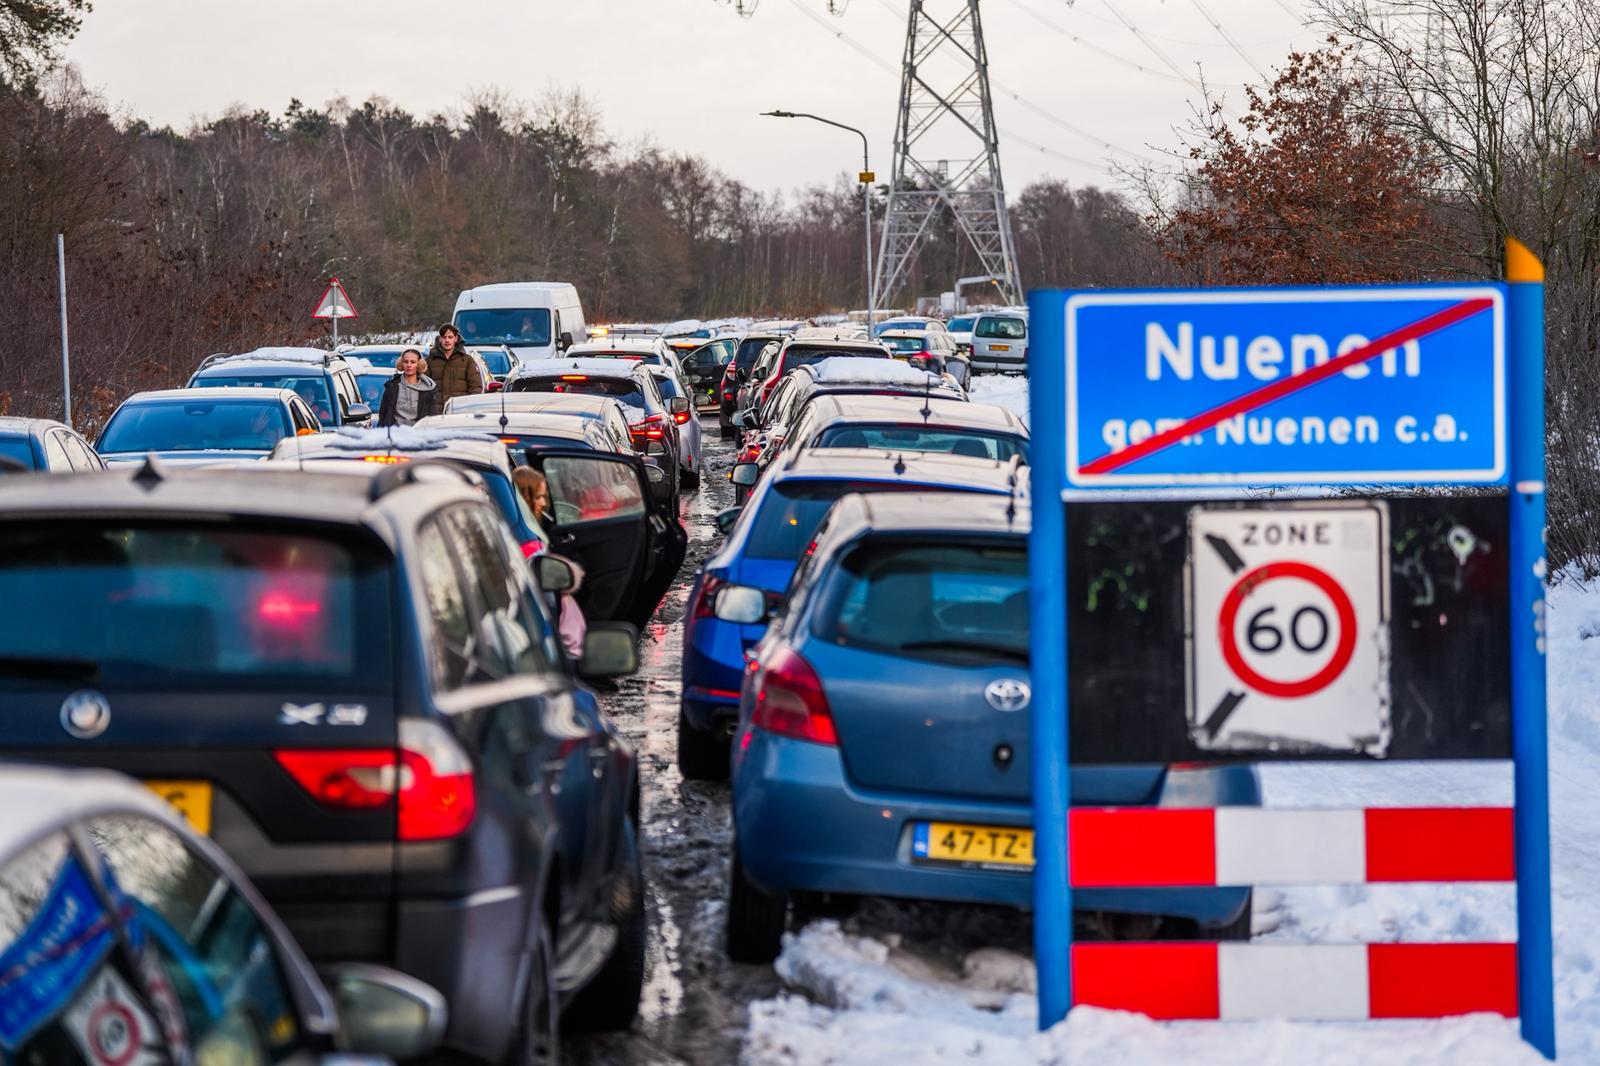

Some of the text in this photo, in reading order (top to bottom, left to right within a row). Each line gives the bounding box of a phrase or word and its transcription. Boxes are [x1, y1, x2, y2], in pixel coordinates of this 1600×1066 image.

[1144, 321, 1421, 381] Nuenen
[1215, 413, 1380, 445] Nuenen
[1394, 414, 1469, 443] c.a.
[1241, 522, 1332, 546] ZONE
[1246, 605, 1329, 655] 60
